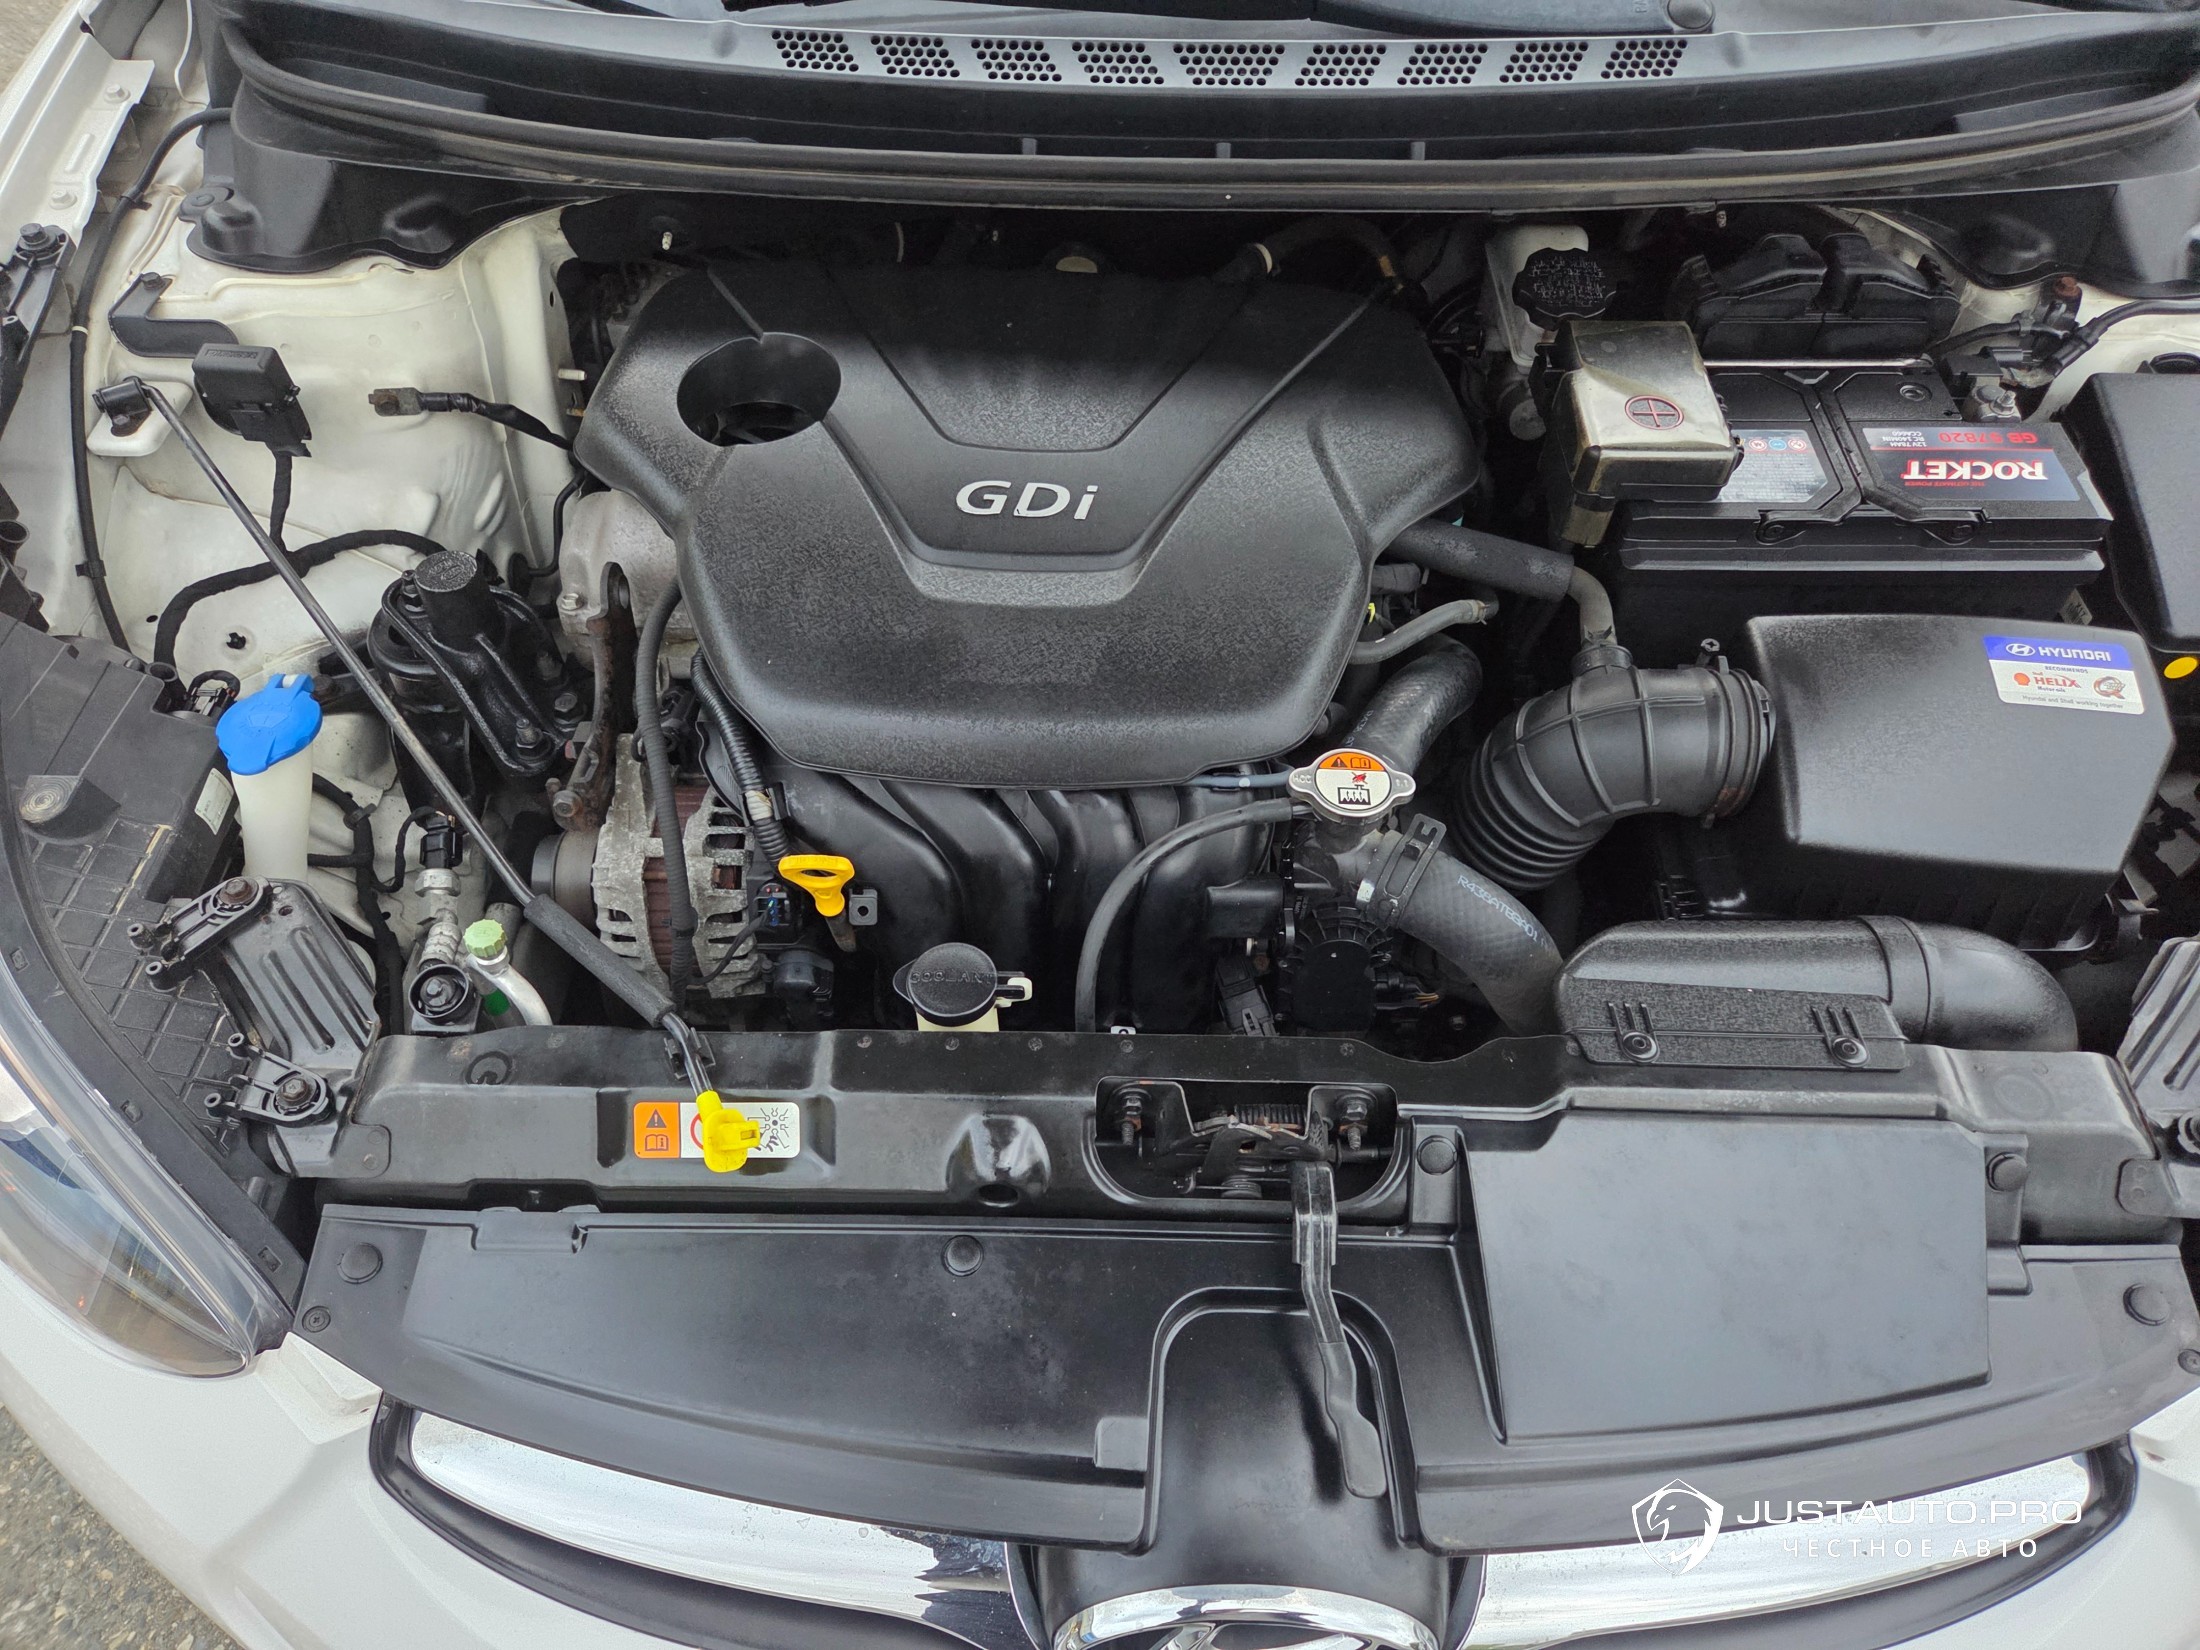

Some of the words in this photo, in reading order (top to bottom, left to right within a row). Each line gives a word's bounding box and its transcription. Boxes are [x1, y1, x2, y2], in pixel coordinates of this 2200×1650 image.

[2007, 431, 2038, 444] GB
[1901, 458, 2048, 481] ROCKET
[956, 480, 1098, 519] GDi
[2038, 646, 2112, 661] HYUNDAI
[2044, 666, 2089, 674] RECOMMENDS
[2034, 676, 2080, 688] HELIX
